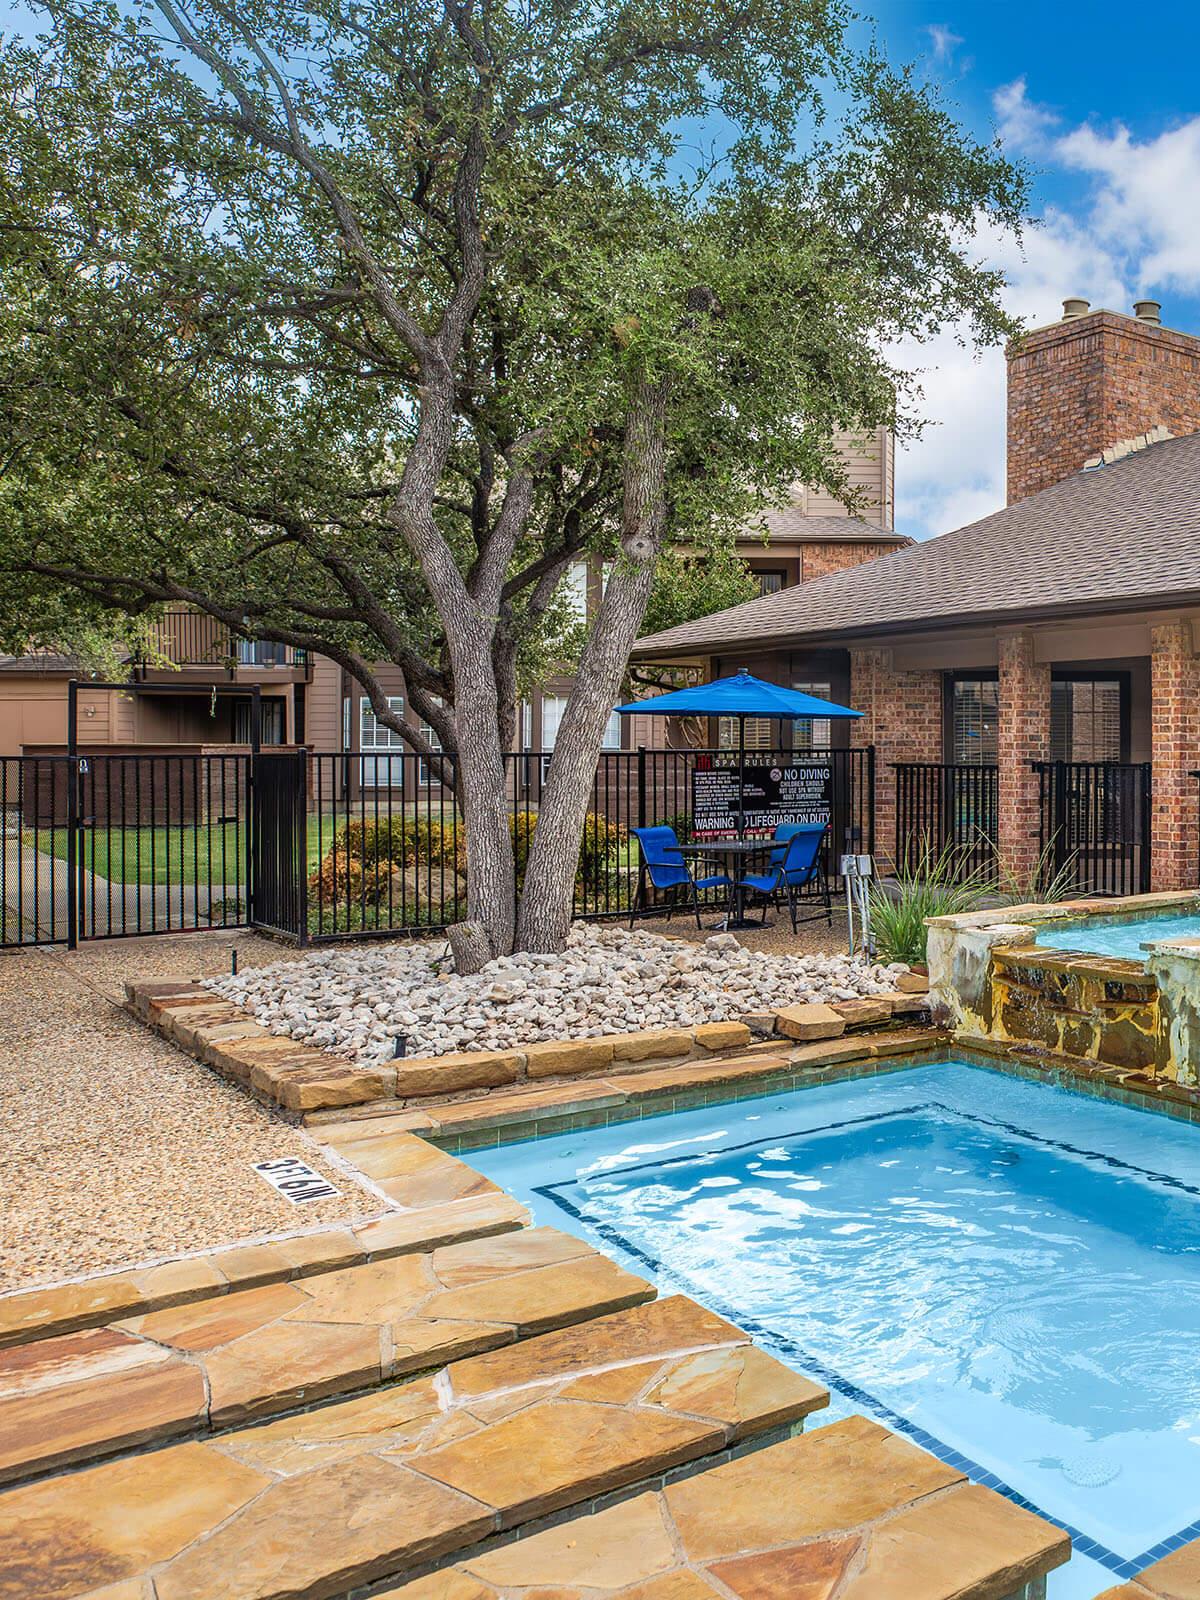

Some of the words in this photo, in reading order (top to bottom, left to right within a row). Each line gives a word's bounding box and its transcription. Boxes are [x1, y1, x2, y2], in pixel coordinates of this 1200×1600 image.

[715, 759, 736, 767] SPA
[744, 758, 777, 767] RULES
[784, 769, 798, 780] NO
[800, 768, 830, 780] DIVING
[780, 780, 804, 788] CHILDREN
[694, 816, 735, 830] WARNING
[750, 814, 795, 827] LIFEGUARD
[796, 814, 809, 824] ON
[809, 812, 831, 824] DUTY
